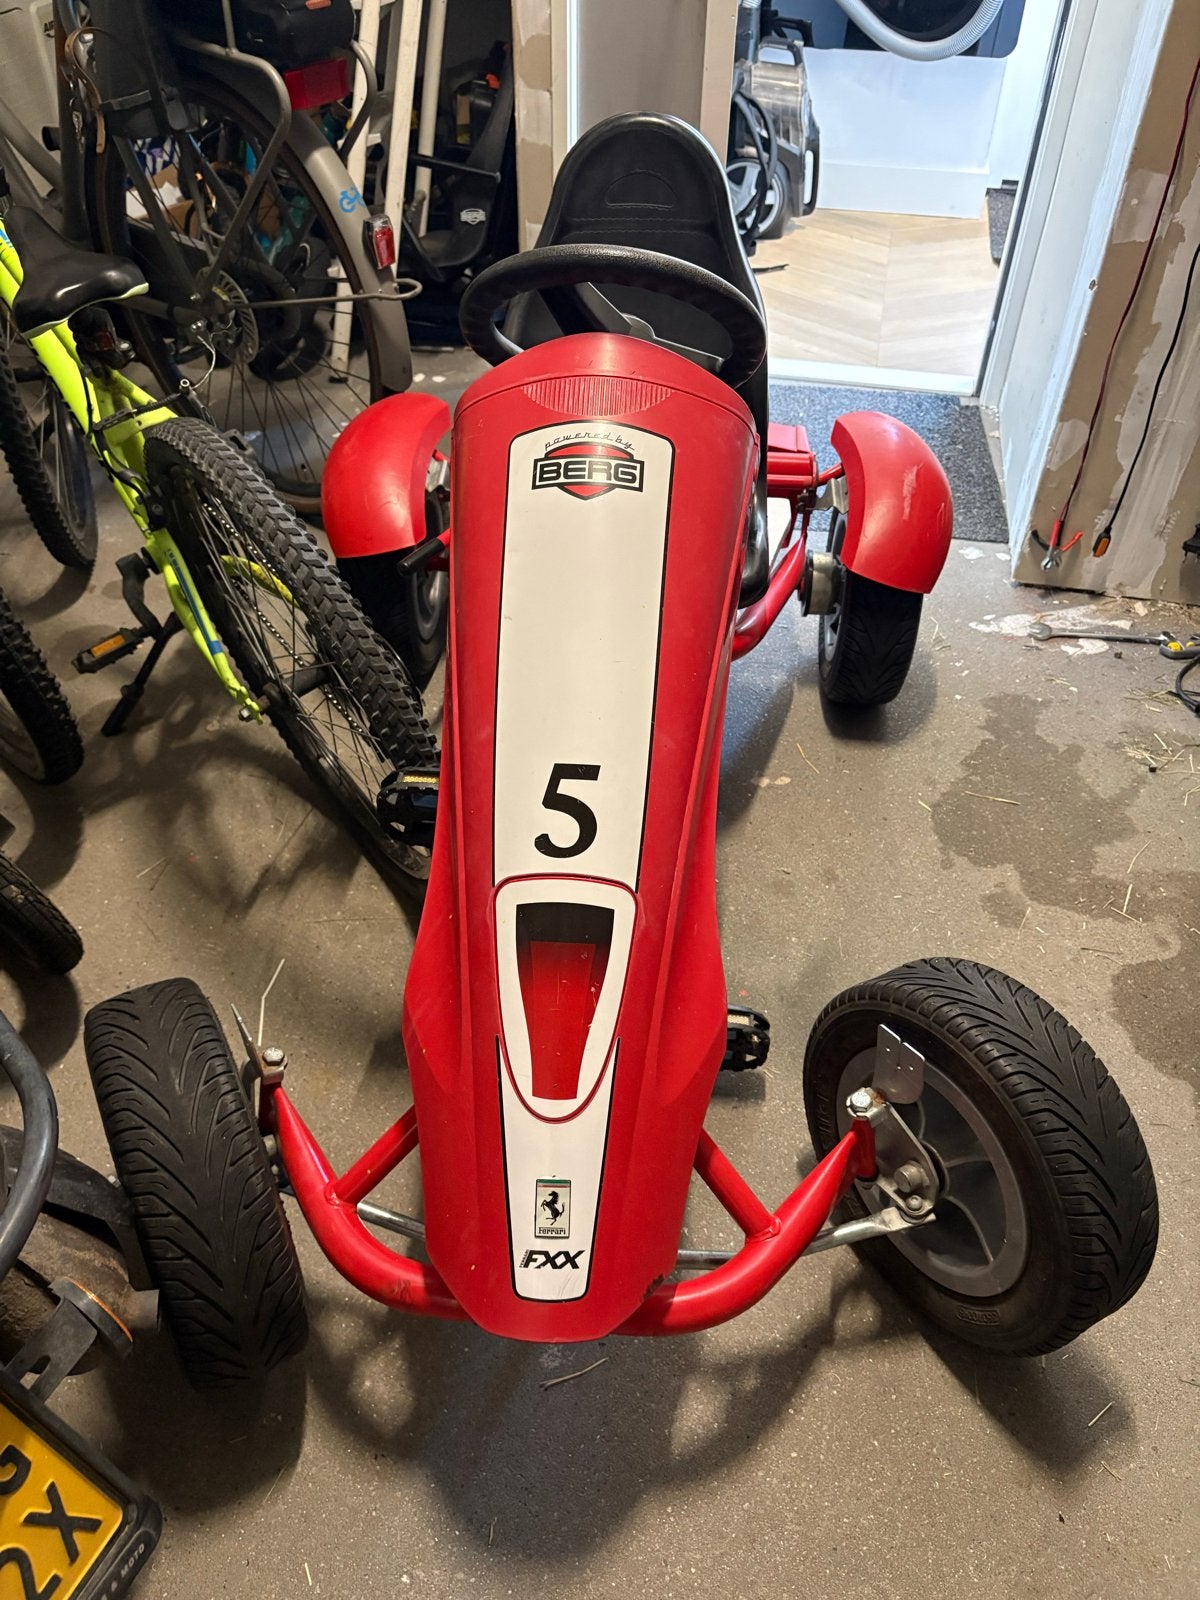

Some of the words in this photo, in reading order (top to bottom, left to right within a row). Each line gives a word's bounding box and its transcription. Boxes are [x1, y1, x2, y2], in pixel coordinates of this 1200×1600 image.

[545, 432, 613, 451] powered
[615, 434, 635, 451] by
[539, 460, 638, 484] BERG
[534, 763, 601, 858] 5
[538, 1226, 567, 1236] Ferrari
[523, 1249, 586, 1270] FXX
[121, 1543, 145, 1578] MOTO
